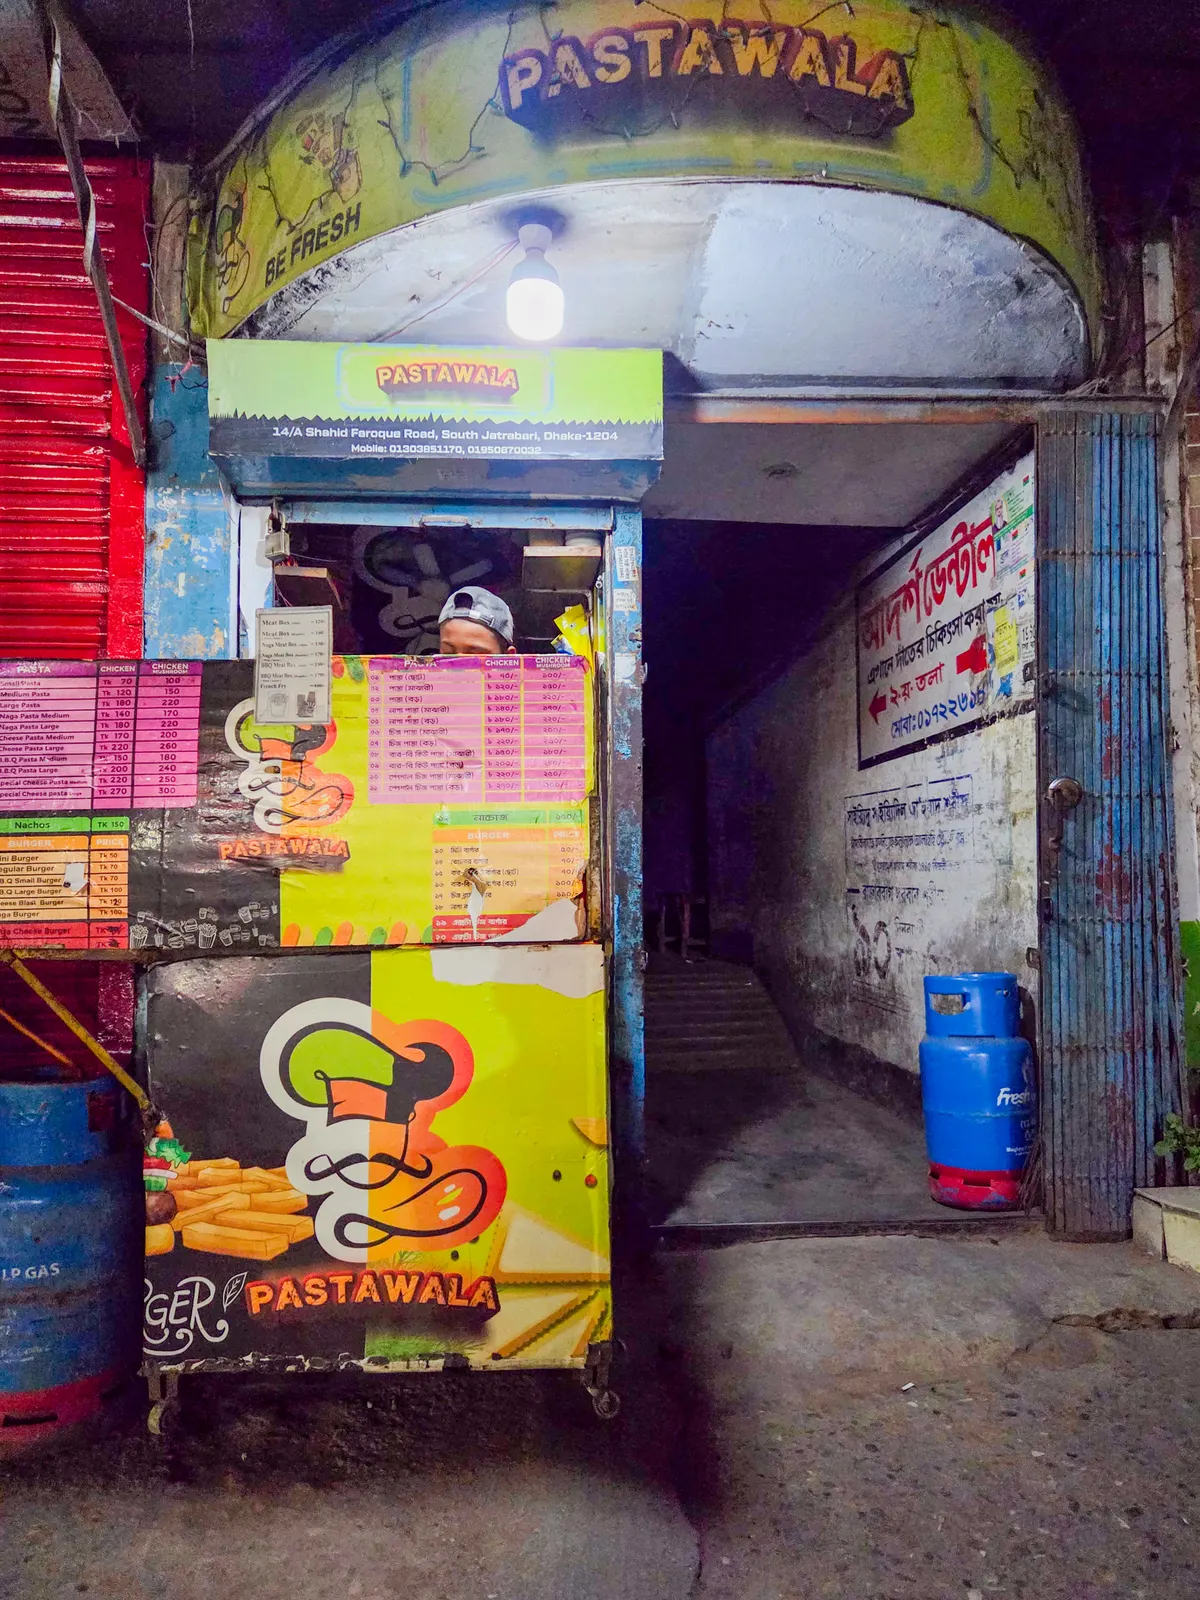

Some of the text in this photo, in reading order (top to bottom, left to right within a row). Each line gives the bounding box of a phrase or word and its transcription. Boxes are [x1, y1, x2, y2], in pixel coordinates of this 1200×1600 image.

[504, 23, 910, 110] PASTAWALA
[264, 202, 362, 288] BE FRESH
[376, 363, 519, 391] PASTAWALA
[272, 427, 302, 437] 14/A
[305, 427, 348, 438] Shahid
[403, 429, 438, 440] Road,
[441, 430, 478, 440] South
[481, 431, 541, 442] Jatrabari,
[543, 431, 618, 441] Dhaka-1204
[351, 444, 387, 453] Mobile:
[860, 516, 995, 650] আদর্শ ডেন্টাল
[926, 611, 964, 657] চিকিৎসা
[17, 665, 51, 673] PASTA
[914, 661, 945, 693] তলা
[14, 821, 50, 829] Nachos
[467, 832, 509, 840] BURGER
[96, 838, 125, 846] PRICE
[218, 837, 350, 861] PASTAWALA
[12, 855, 39, 863] Burger
[26, 865, 54, 873] Burger
[37, 877, 61, 885] Burger
[37, 888, 62, 896] Burger
[13, 911, 39, 919] Burger
[44, 927, 71, 935] Burger
[2, 1262, 60, 1279] LP GAS
[246, 1270, 499, 1316] PASTAWALA
